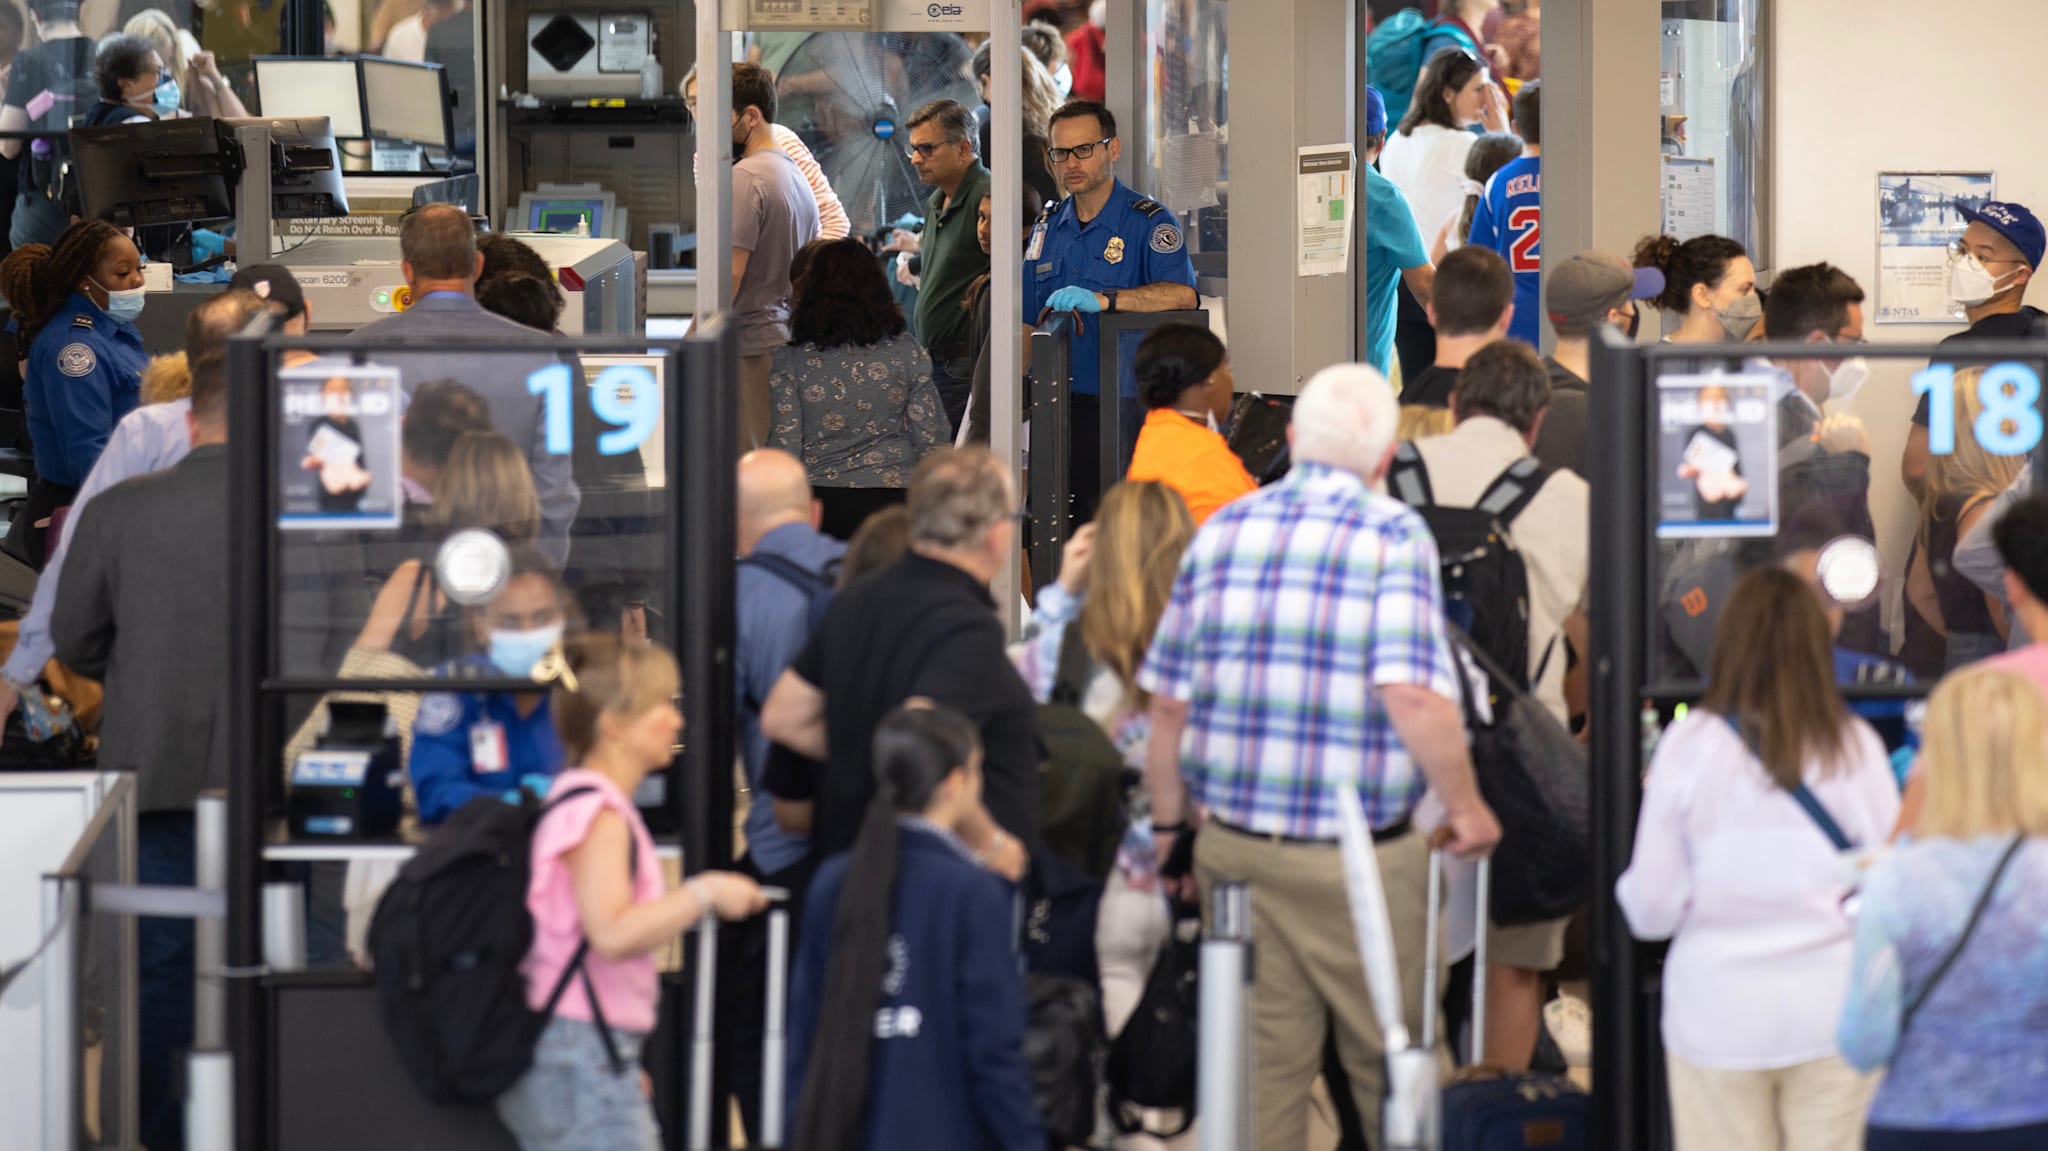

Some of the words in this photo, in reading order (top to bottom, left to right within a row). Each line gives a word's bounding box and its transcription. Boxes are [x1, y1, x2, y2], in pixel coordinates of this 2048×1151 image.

[339, 215, 384, 226] Screening
[290, 225, 303, 234] Do
[305, 225, 321, 234] Not
[322, 225, 350, 234] Reach
[351, 225, 374, 234] Over
[1892, 307, 1920, 317] NTAS
[359, 391, 389, 415] ID
[526, 363, 660, 456] 19
[1909, 361, 2045, 457] 18
